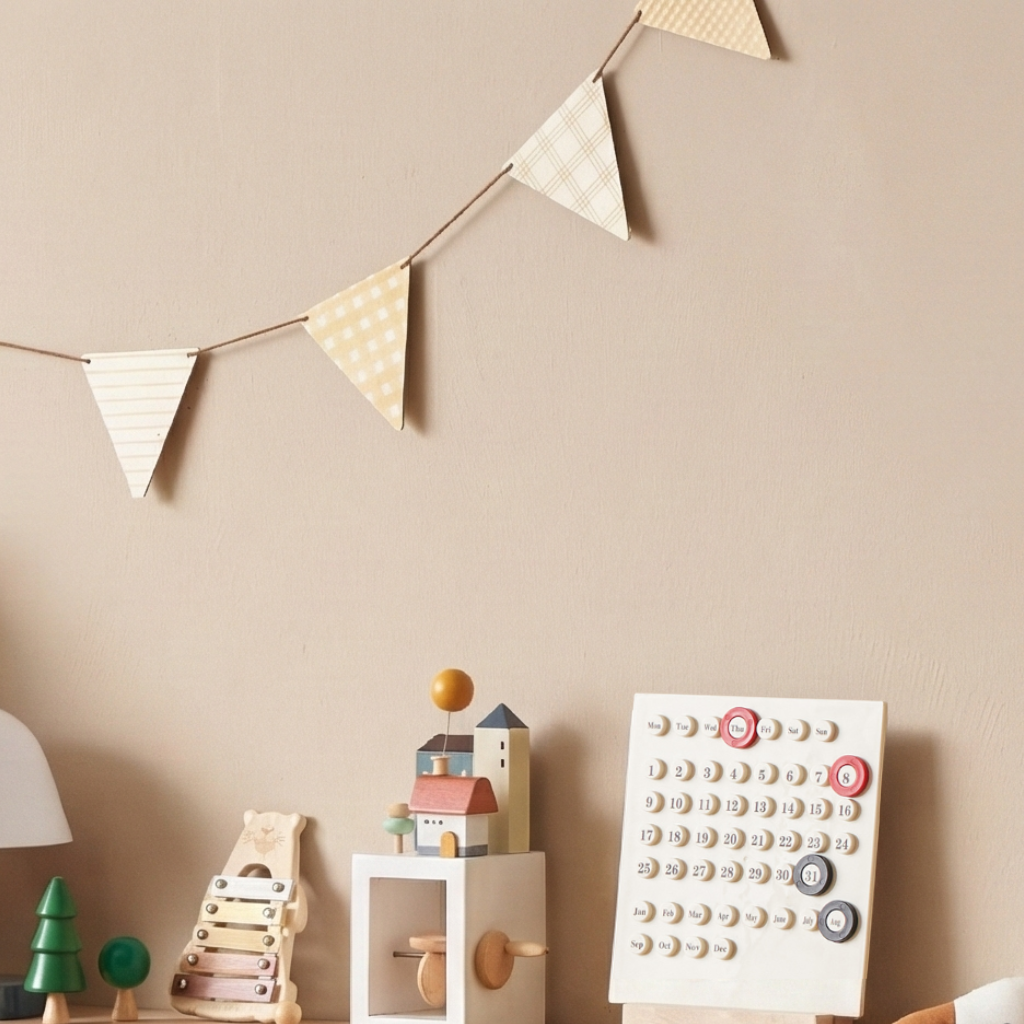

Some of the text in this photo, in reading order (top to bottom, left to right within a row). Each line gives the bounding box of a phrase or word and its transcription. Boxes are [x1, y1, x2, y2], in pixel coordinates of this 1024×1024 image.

[647, 721, 828, 736] Mon Tue Wed Thu Fri Sat Sun
[648, 765, 850, 784] 1 2 3 4 5 6 7 8
[645, 796, 851, 816] 9 10 11 12 13 14 15 16
[640, 829, 849, 850] 17 18 19 20 21 22 23 24
[637, 862, 817, 882] 25 26 27 28 29 30 31
[633, 907, 646, 916] Jan
[662, 908, 674, 917] Feb
[630, 939, 727, 953] Sep Oct Nov Dec
